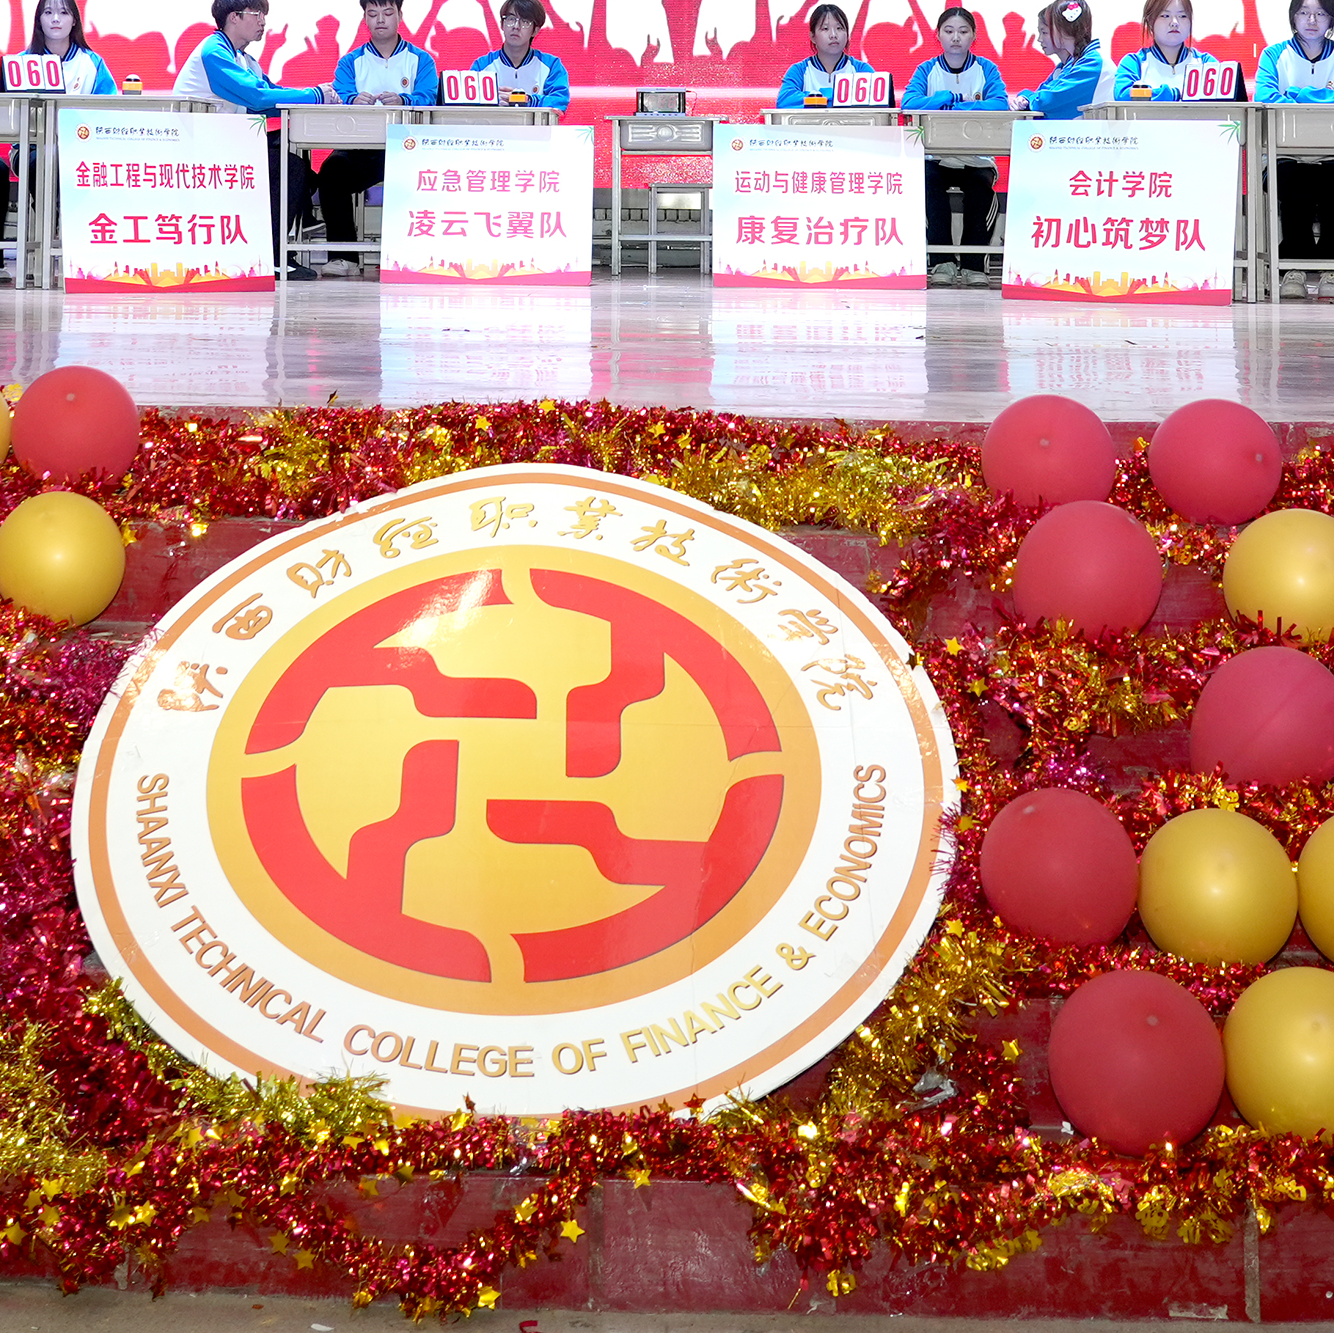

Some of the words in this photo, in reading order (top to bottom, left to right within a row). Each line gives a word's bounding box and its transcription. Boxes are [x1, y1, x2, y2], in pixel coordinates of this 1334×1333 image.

[8, 60, 60, 88] 060
[446, 75, 495, 101] 060
[1186, 67, 1233, 98] 060
[837, 77, 886, 103] 060
[75, 161, 256, 190] 金融工程与现代技术学院
[417, 169, 560, 193] 应急管理学院
[735, 170, 904, 195] 运动与健康管理学院
[1069, 170, 1173, 198] 会计学院
[88, 212, 248, 245] 金工笃行队
[407, 209, 567, 239] 凌云飞翼队
[736, 215, 904, 246] 康复治疗队
[1031, 216, 1206, 251] 初心筑梦队
[136, 773, 189, 908] SHAANXI
[170, 905, 327, 1043] TECHNICAL
[343, 1024, 535, 1078] COLLEGE
[552, 1037, 607, 1075] OF
[620, 964, 783, 1064] FINANCE
[775, 942, 816, 970] &
[798, 764, 887, 942] ECONOMICS
